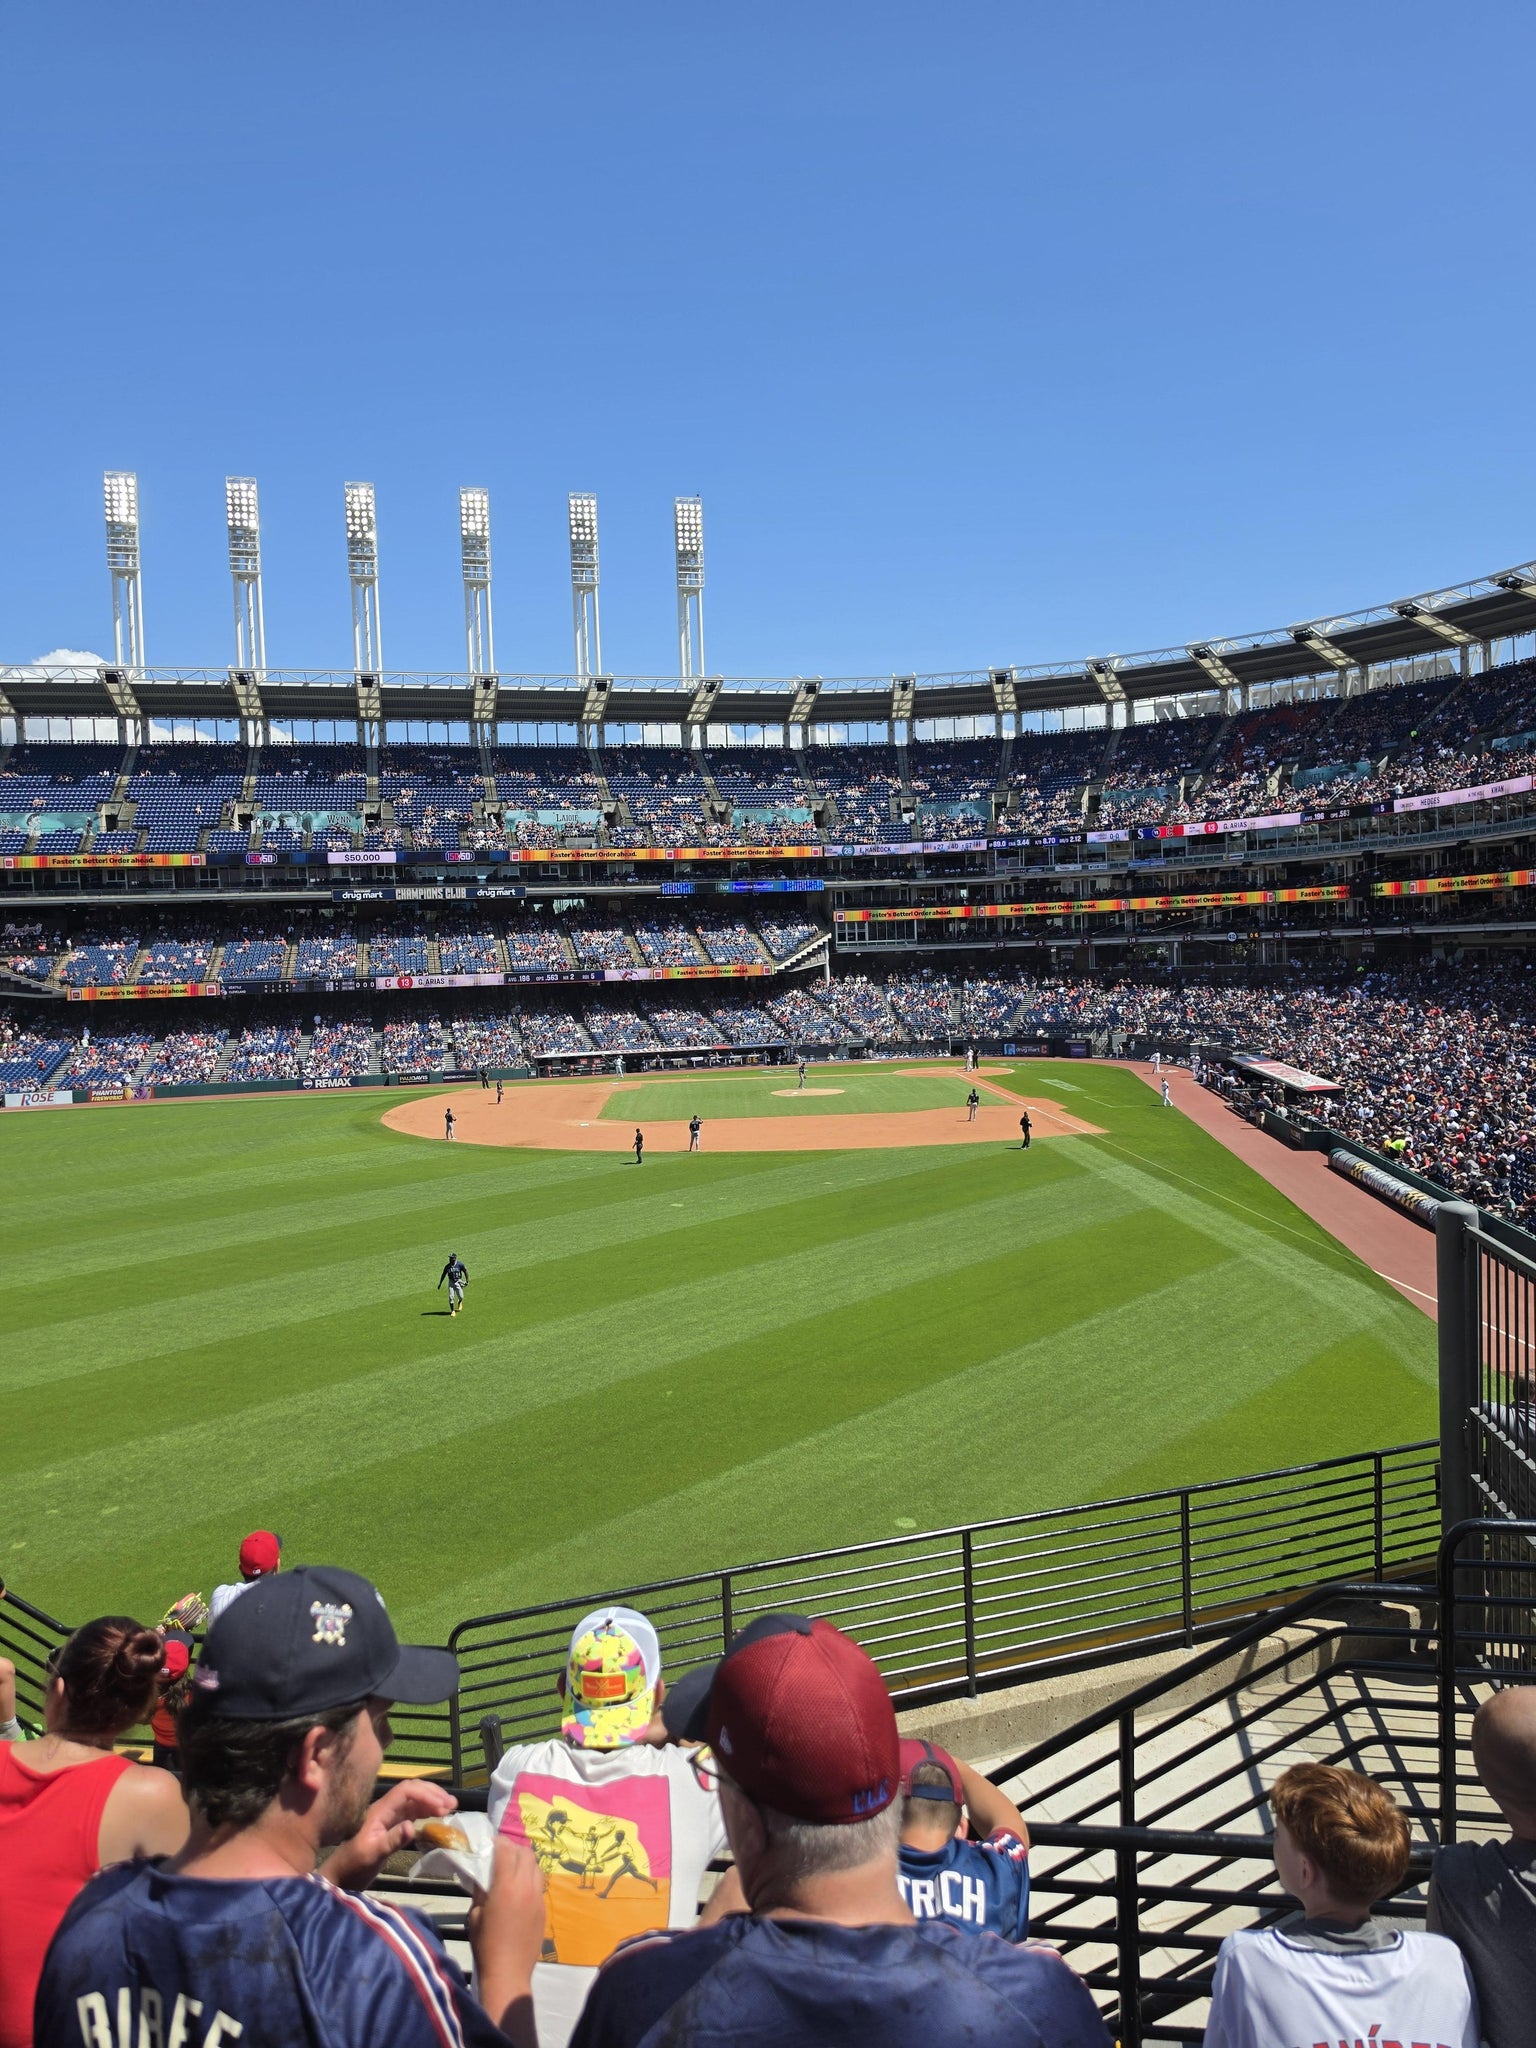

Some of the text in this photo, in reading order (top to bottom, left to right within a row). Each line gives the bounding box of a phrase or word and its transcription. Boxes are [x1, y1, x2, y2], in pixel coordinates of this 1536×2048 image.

[1420, 796, 1440, 806] HEDGES
[616, 850, 638, 858] ahead.
[52, 856, 155, 866] Faster's Better! Order ahead.
[1437, 876, 1510, 888] Faster's Better! Order ahead.
[342, 890, 363, 900] drug
[364, 890, 382, 899] mart
[396, 888, 466, 900] CHAMPIONS CLUB
[477, 888, 499, 898] drug
[500, 888, 516, 897] mart
[1300, 890, 1326, 898] Faster's
[1156, 898, 1180, 906] Faster's
[1203, 896, 1221, 904] Order
[1036, 904, 1056, 912] Better!
[892, 910, 913, 918] Better!
[425, 978, 444, 986] ARIAS
[126, 988, 148, 996] Better!
[92, 1089, 124, 1098] PHANTOM
[20, 1092, 54, 1106] ROSE
